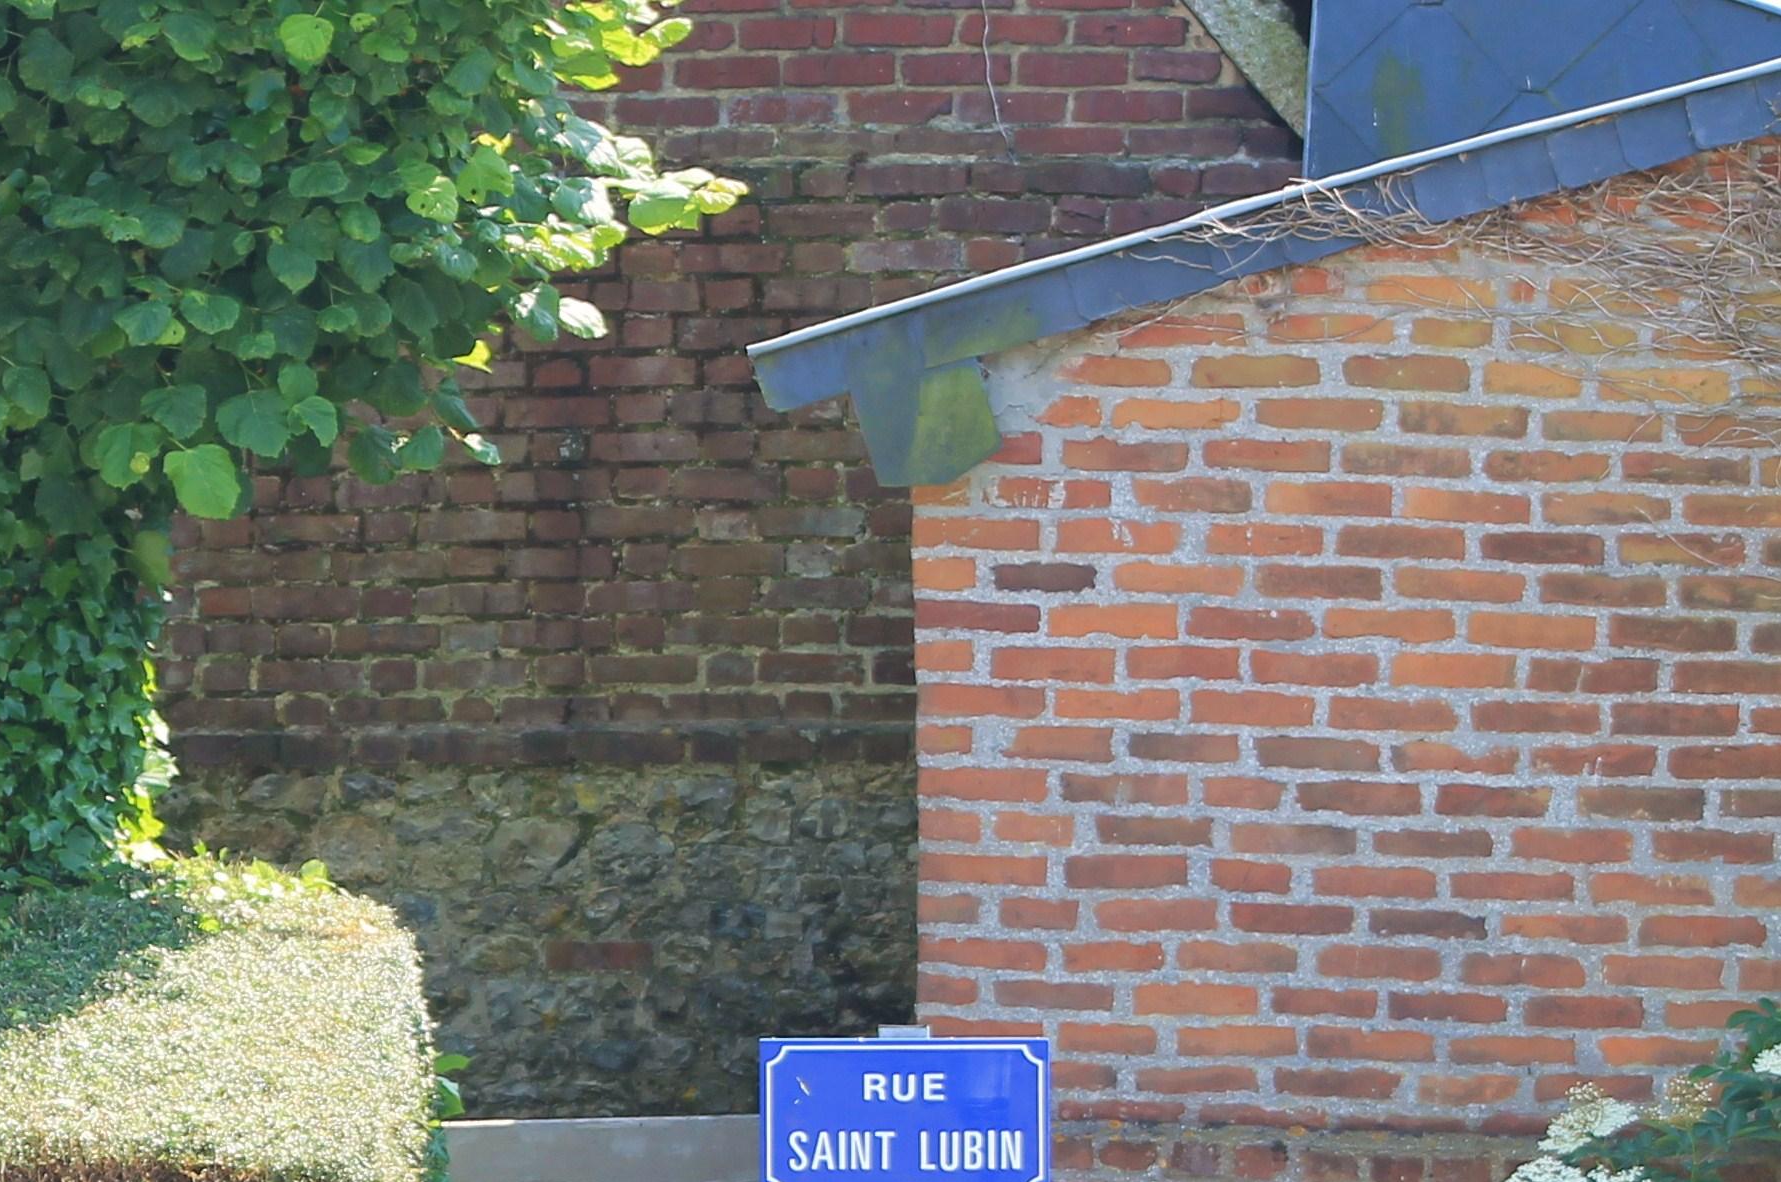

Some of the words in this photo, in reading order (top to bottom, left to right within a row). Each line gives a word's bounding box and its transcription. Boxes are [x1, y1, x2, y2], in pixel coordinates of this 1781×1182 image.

[862, 1072, 947, 1103] RUE
[788, 1129, 897, 1172] SAINT
[919, 1129, 1024, 1173] LUBIN
